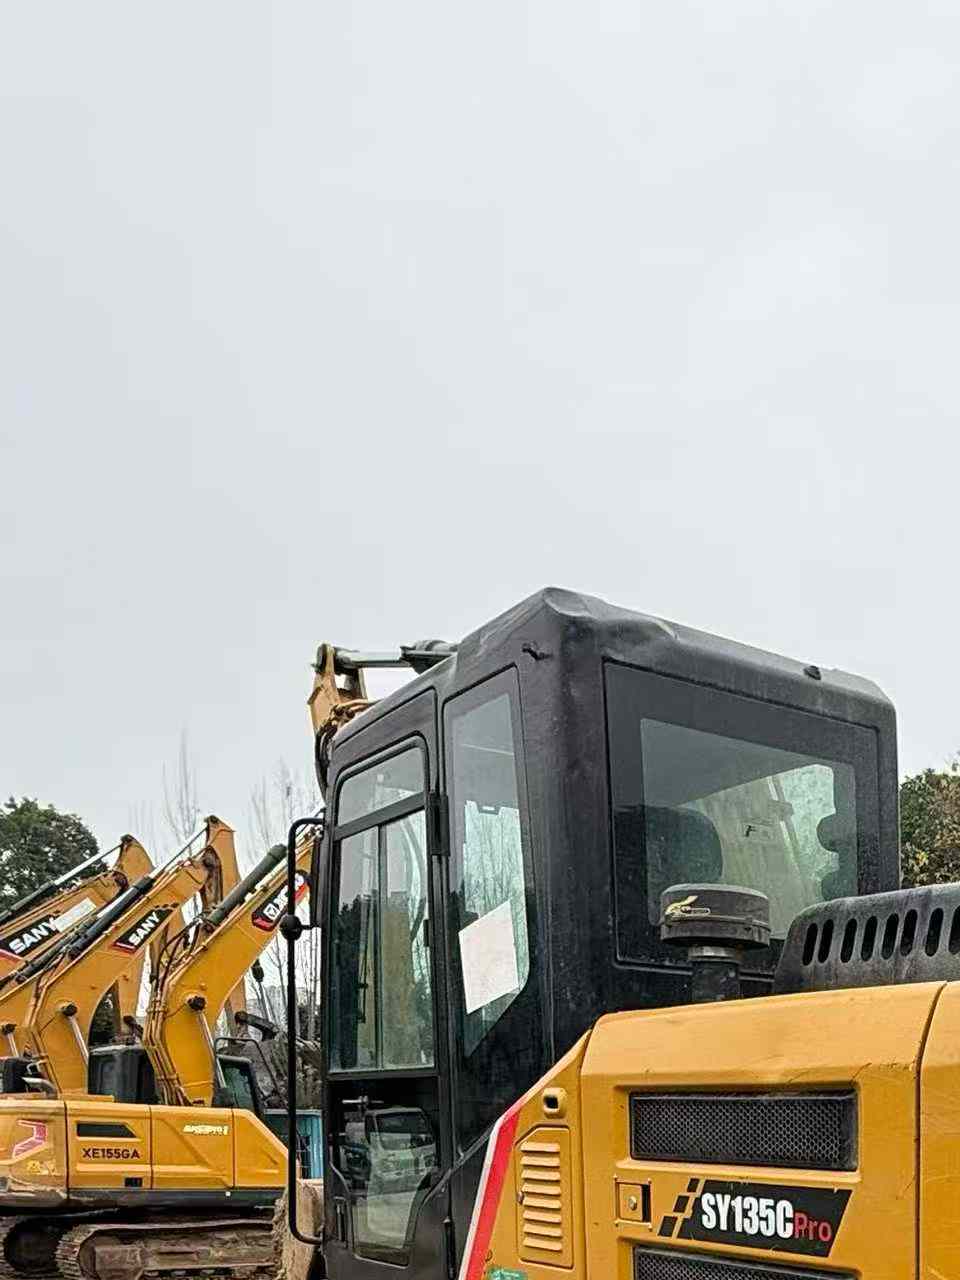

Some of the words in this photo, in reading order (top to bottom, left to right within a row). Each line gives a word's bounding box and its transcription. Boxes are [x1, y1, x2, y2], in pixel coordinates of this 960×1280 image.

[8, 917, 57, 954] SANY
[128, 911, 161, 946] SANY
[82, 1148, 140, 1159] XE155GA
